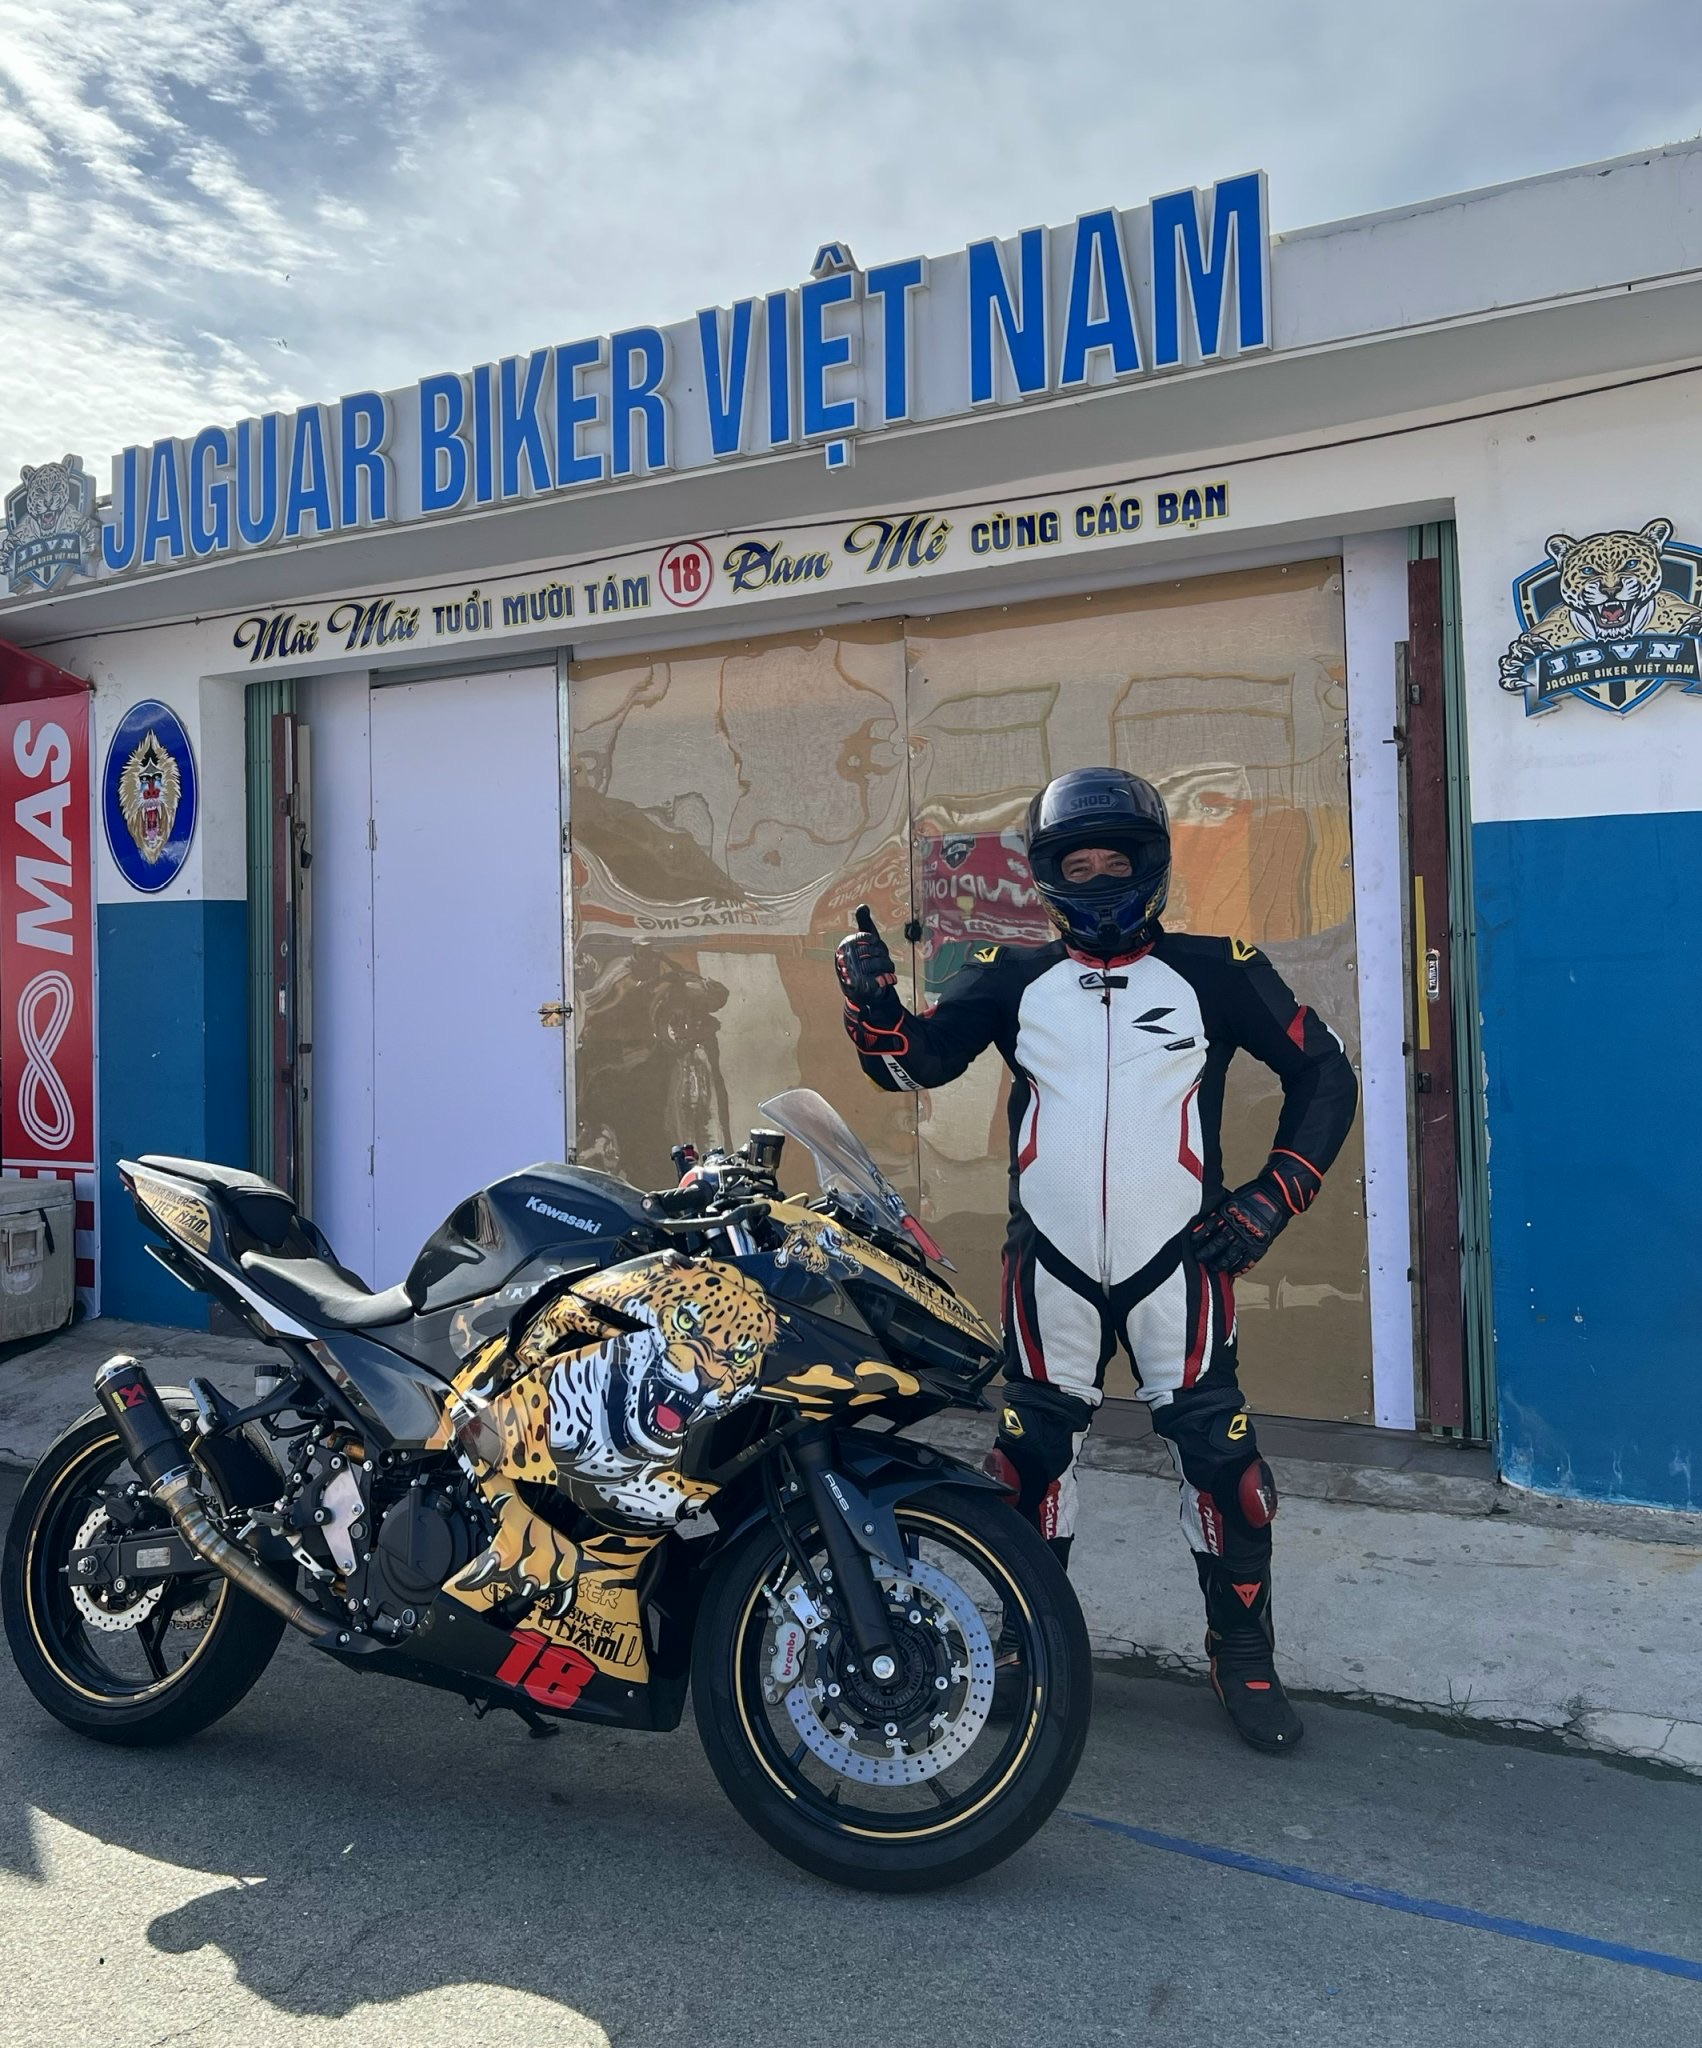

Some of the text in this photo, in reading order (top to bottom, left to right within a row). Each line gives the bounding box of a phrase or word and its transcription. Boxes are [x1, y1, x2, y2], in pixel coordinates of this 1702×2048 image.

[103, 170, 1267, 572] JAGUAR BIKER VIỆT NAM
[843, 513, 952, 573] Mê
[970, 510, 1059, 555] CÙNG
[1074, 493, 1143, 537] CÁC
[1156, 481, 1229, 529] BẠN
[667, 554, 701, 594] 18
[232, 573, 651, 663] Mãi Mãi TUỔI MƯỜI TÁM
[1545, 672, 1589, 691] JAGUAR
[1594, 664, 1629, 679] BIKER
[1666, 663, 1694, 674] NAM
[1069, 794, 1111, 811] SHOEI
[13, 719, 73, 955] MAS
[525, 1195, 602, 1235] Kawasaki
[824, 1473, 850, 1512] ABS
[495, 1630, 599, 1710] 18
[782, 1631, 797, 1677] brembo
